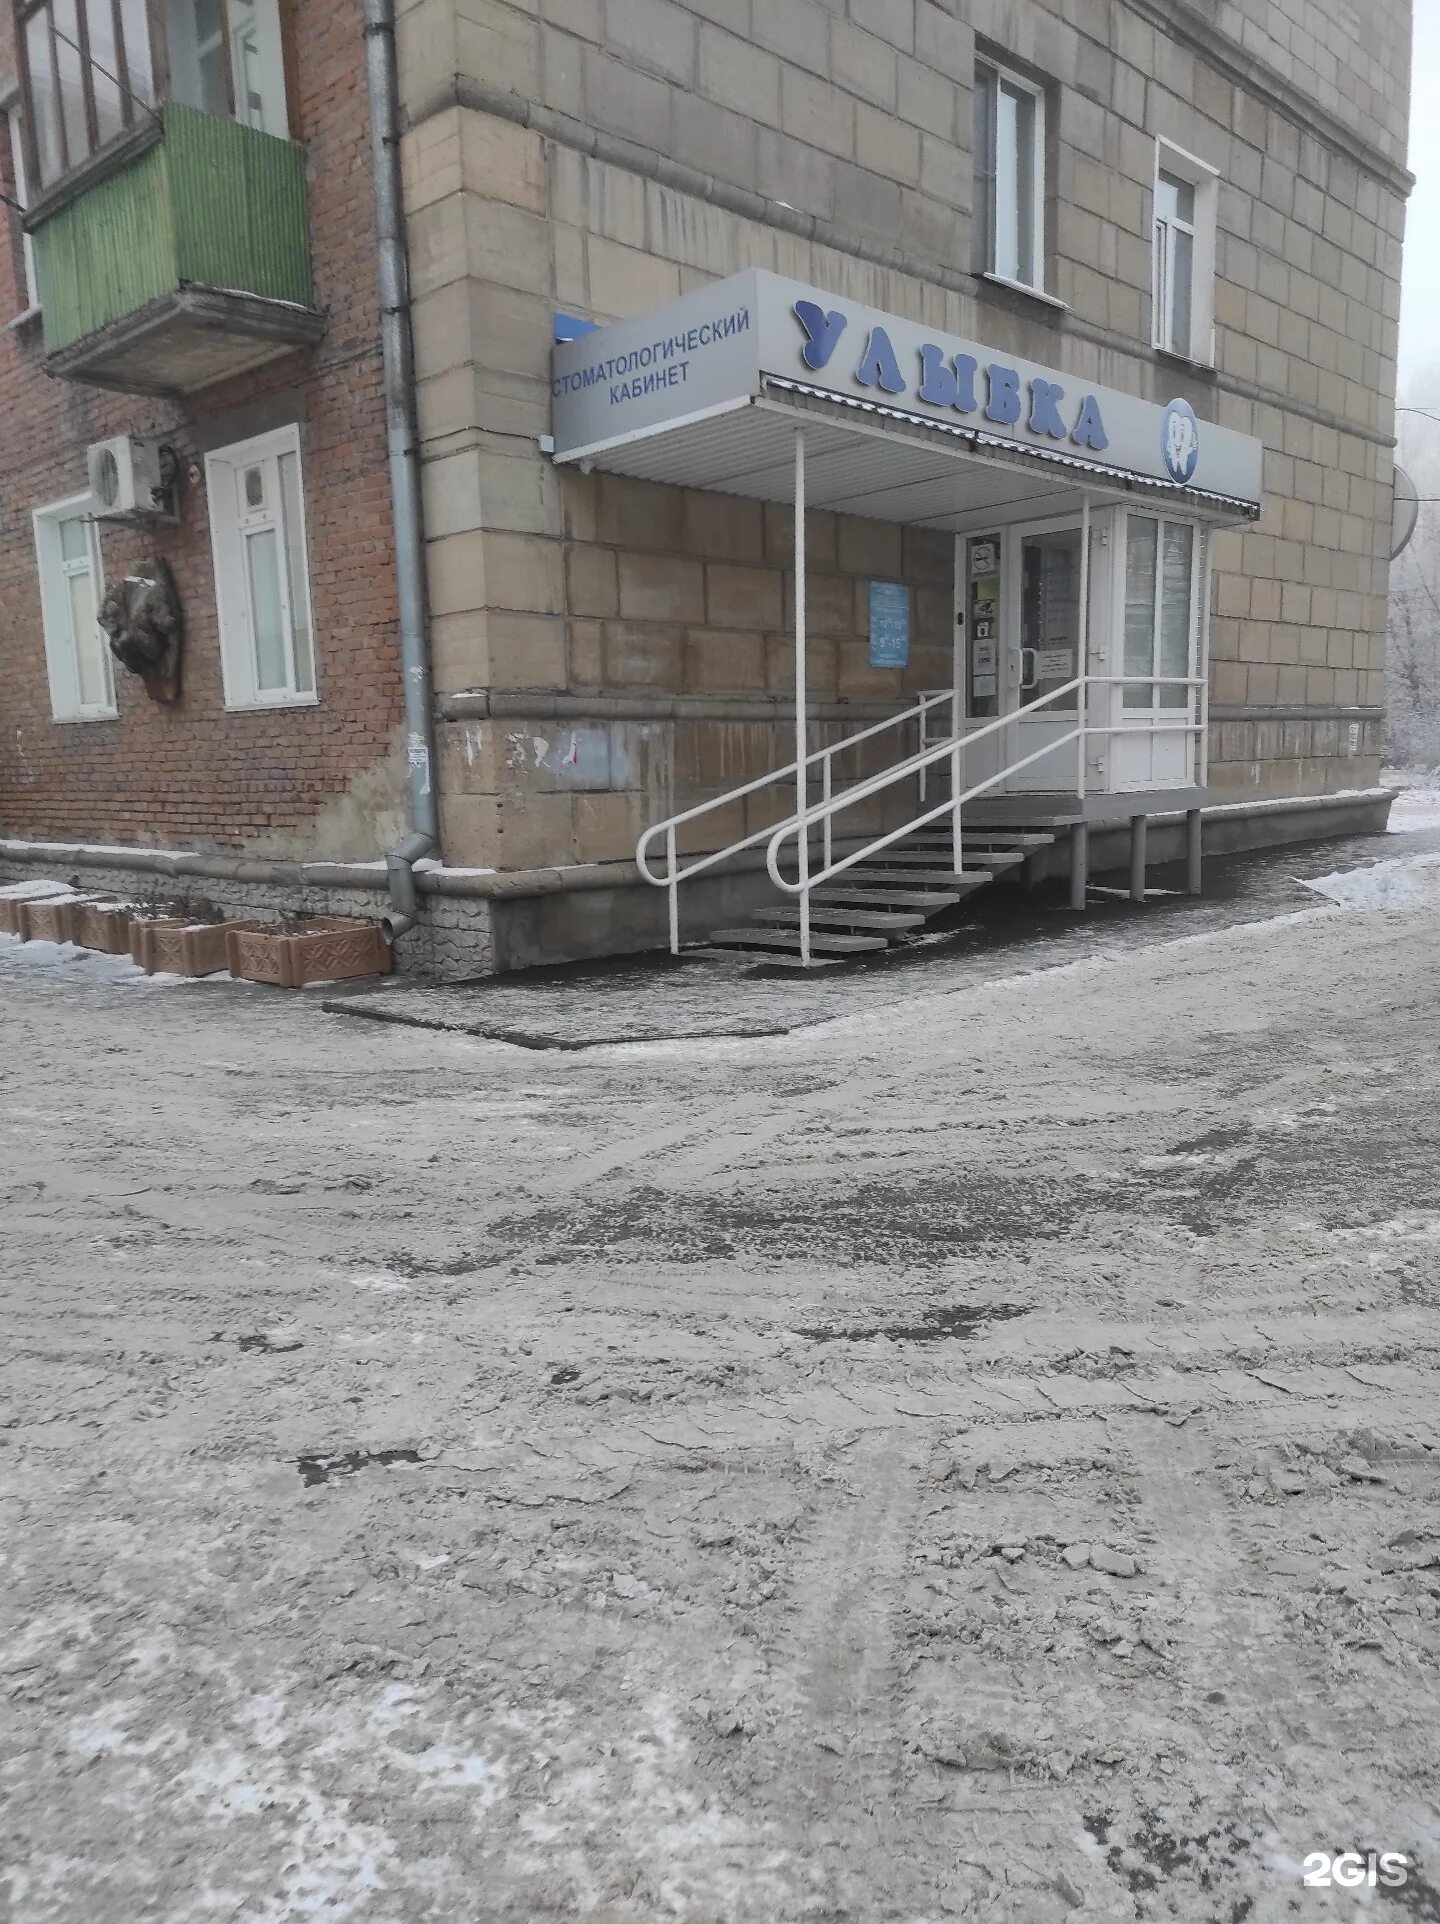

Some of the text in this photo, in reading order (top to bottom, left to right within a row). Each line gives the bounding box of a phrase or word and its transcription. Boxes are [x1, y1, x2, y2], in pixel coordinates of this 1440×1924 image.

[552, 305, 750, 397] СТОМАТОЛОГИЧЕСКИЙ
[610, 361, 690, 404] КАБИНЕТ
[793, 300, 1109, 450] УЛЫБКА
